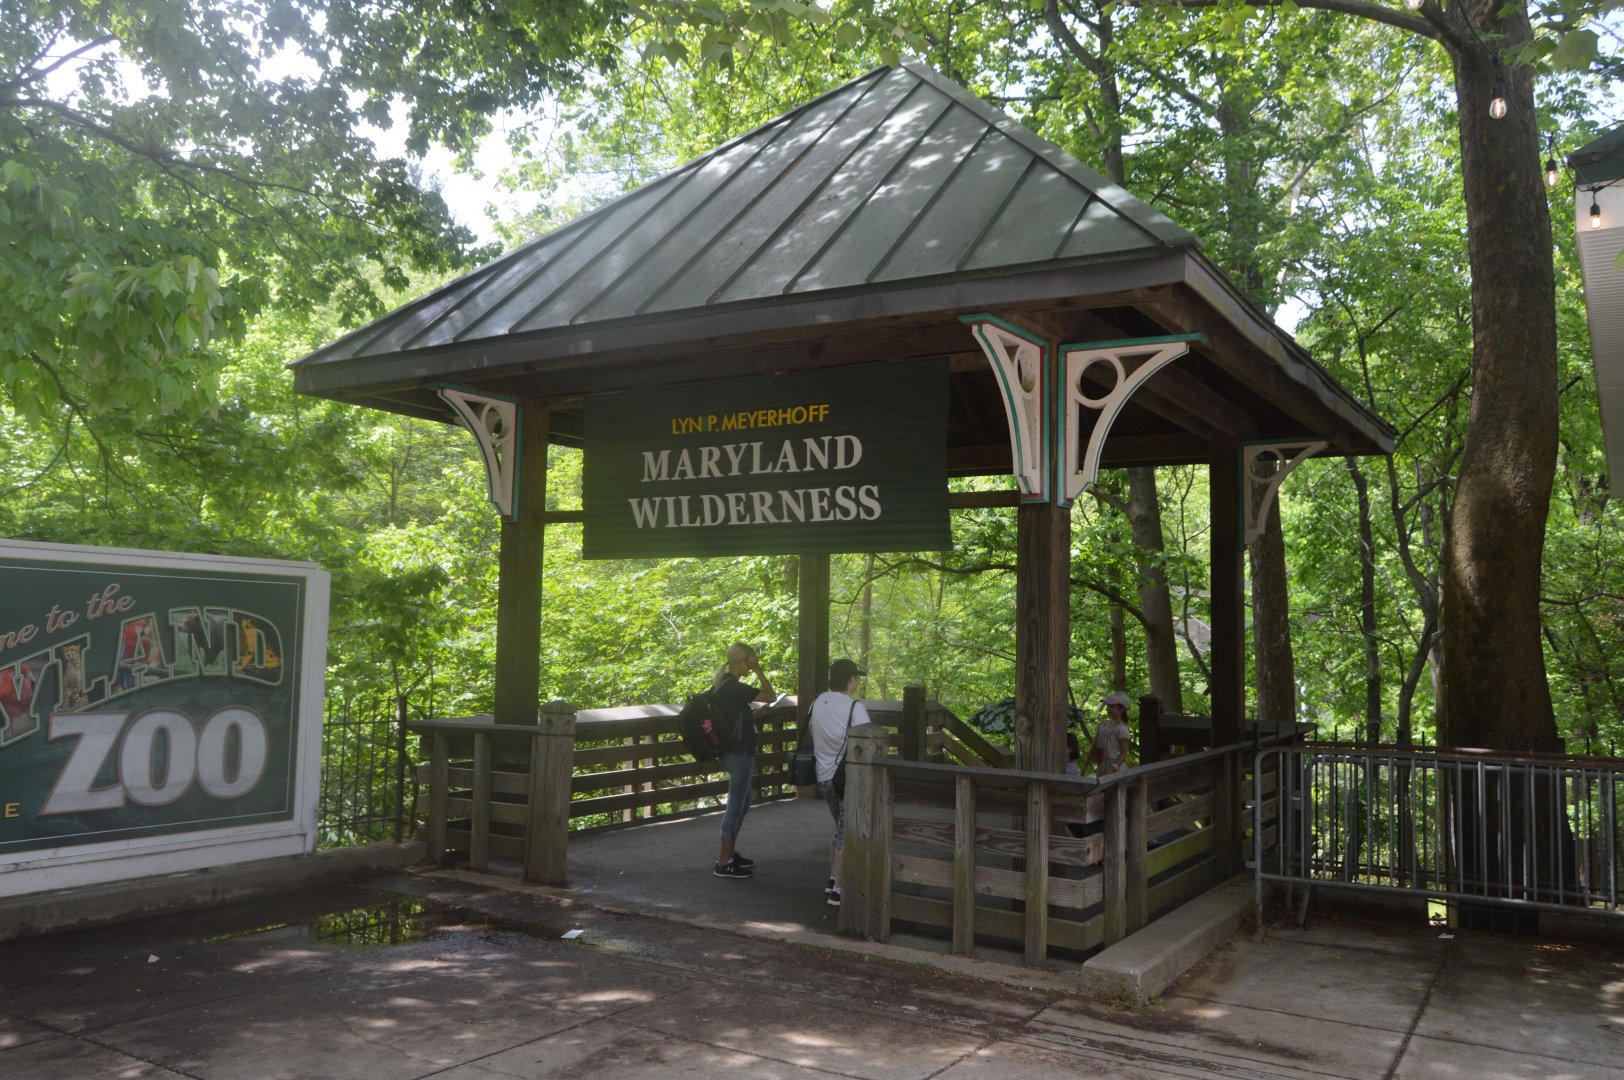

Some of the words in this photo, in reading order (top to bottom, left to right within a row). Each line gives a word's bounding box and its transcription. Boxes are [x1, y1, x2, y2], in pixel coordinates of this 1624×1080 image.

[671, 416, 703, 435] LYN
[707, 414, 719, 433] P.
[721, 404, 830, 431] MEYERHOFF
[641, 434, 863, 482] MARYLAND
[628, 485, 882, 529] WILDERNESS
[46, 604, 80, 634] to
[86, 583, 136, 620] the
[38, 704, 270, 816] ZOO
